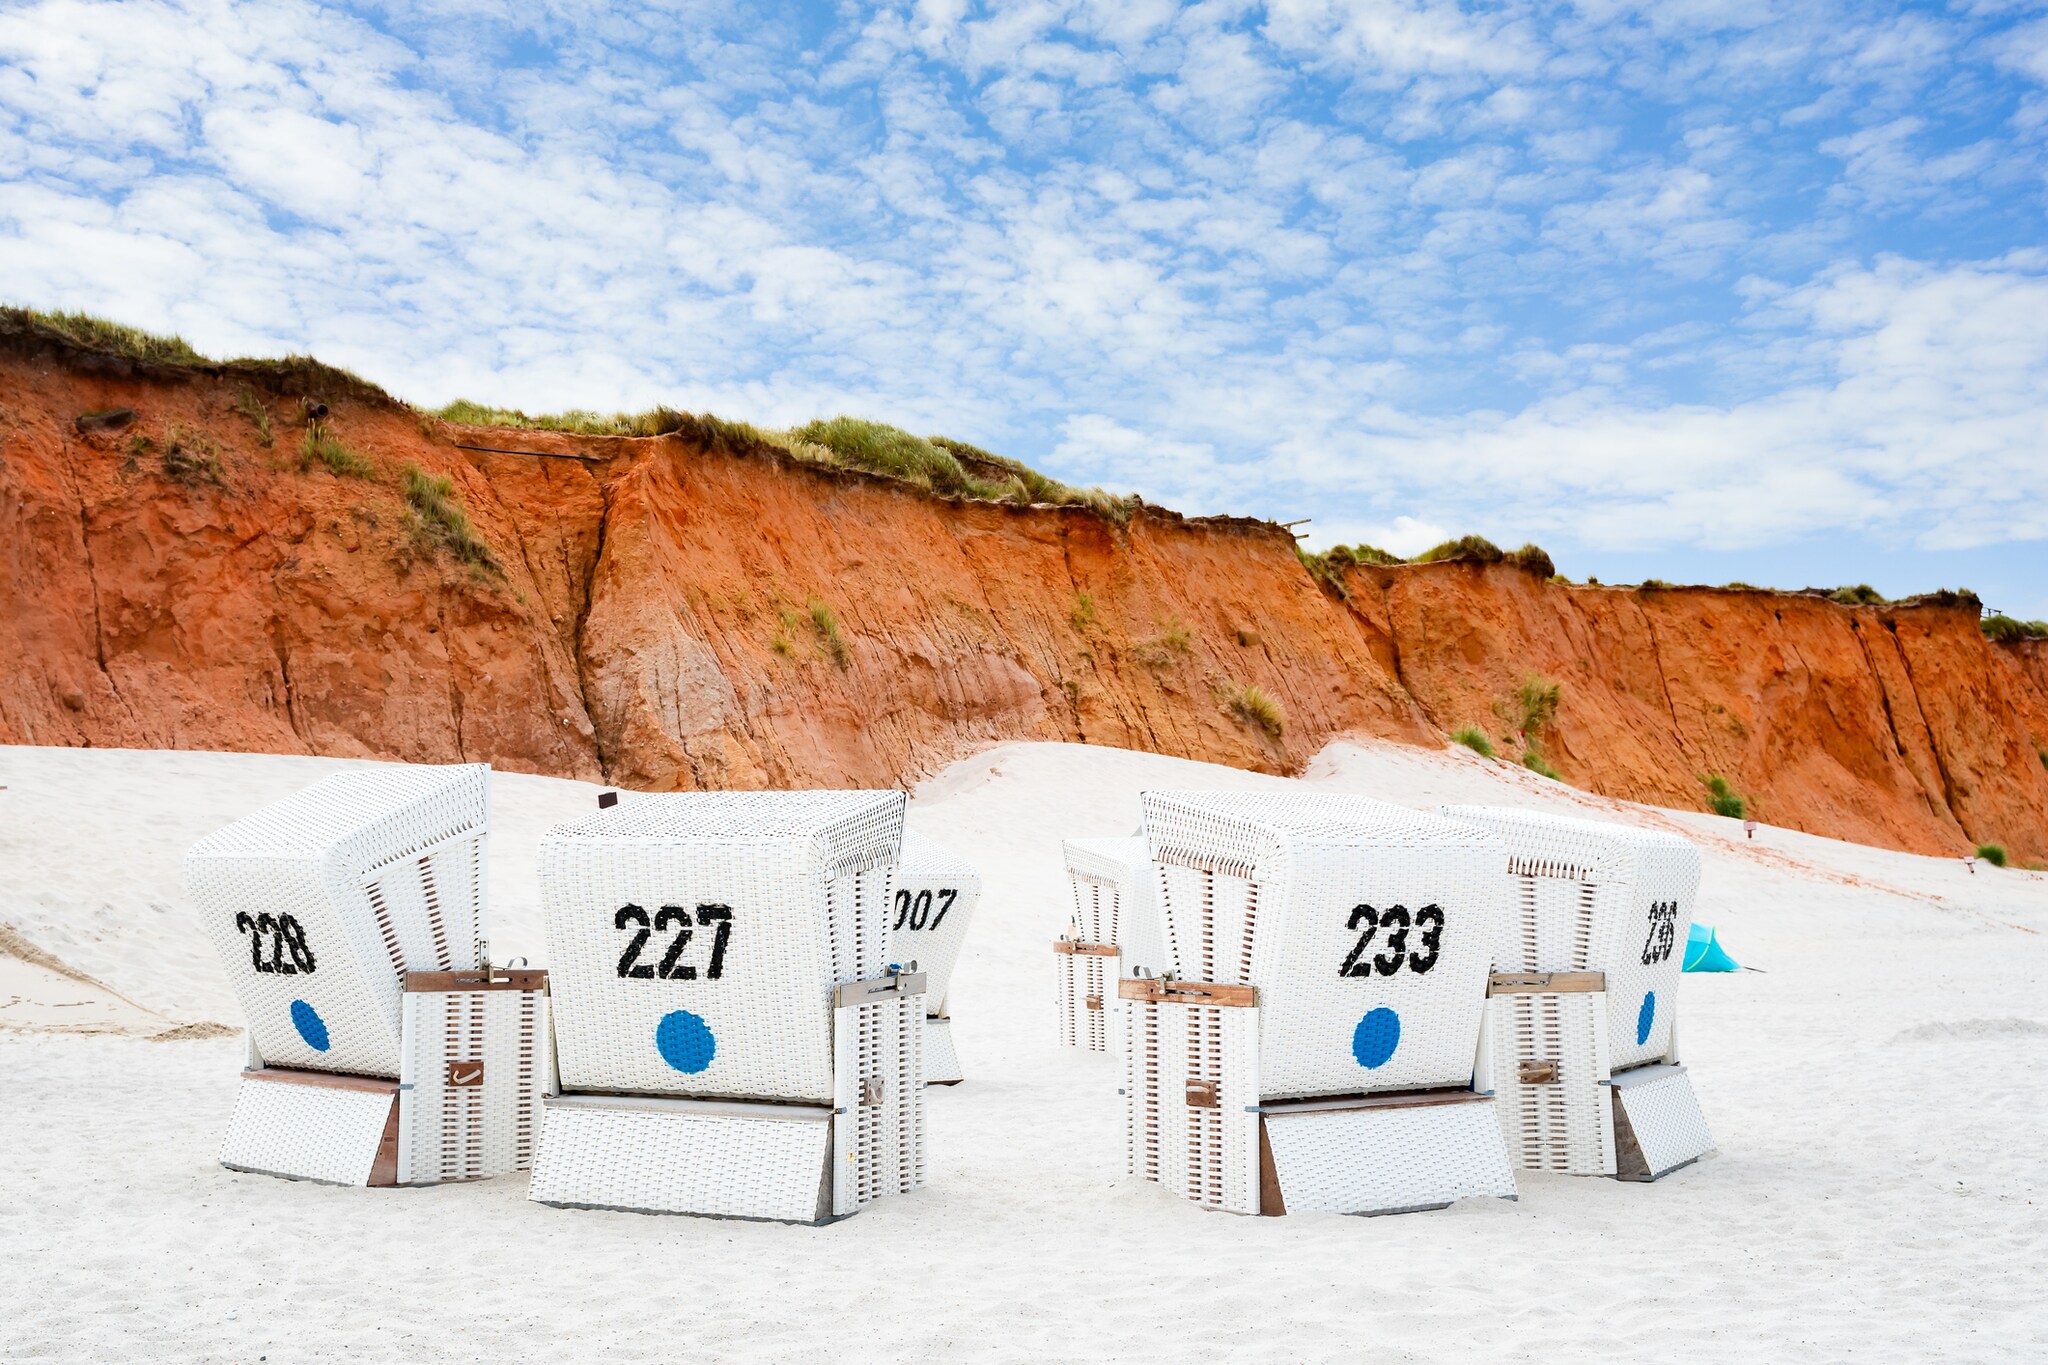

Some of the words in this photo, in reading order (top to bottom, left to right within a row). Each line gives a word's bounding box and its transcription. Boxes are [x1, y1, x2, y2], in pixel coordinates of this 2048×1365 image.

[236, 911, 317, 974] 228
[615, 902, 735, 980] 227
[1338, 903, 1445, 977] 233
